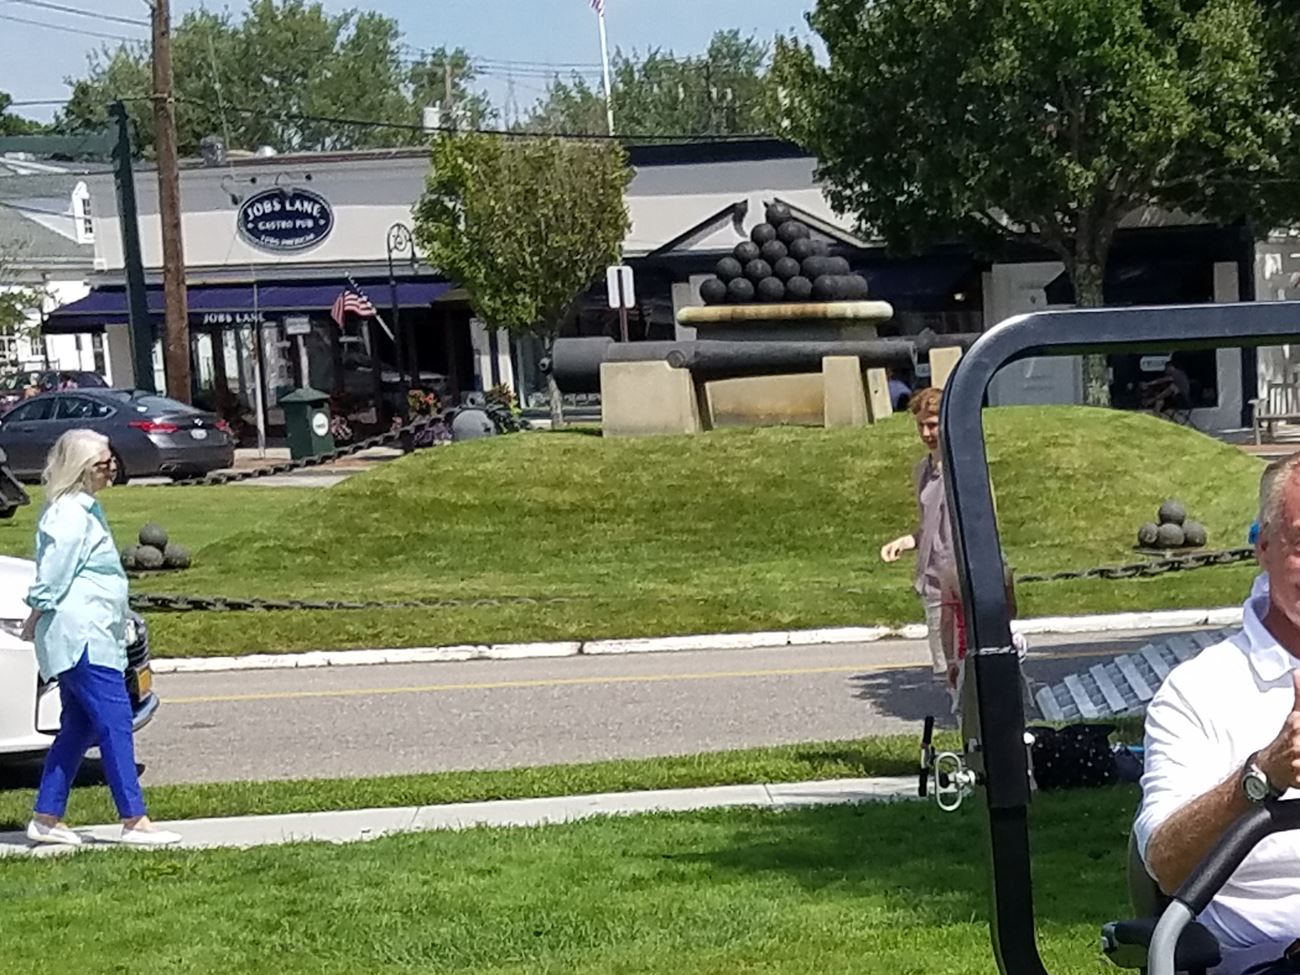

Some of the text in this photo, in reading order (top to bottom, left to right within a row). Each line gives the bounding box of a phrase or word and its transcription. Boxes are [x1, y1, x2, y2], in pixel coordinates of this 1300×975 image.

[247, 198, 322, 220] JOBS LANE
[203, 313, 233, 324] JOBS
